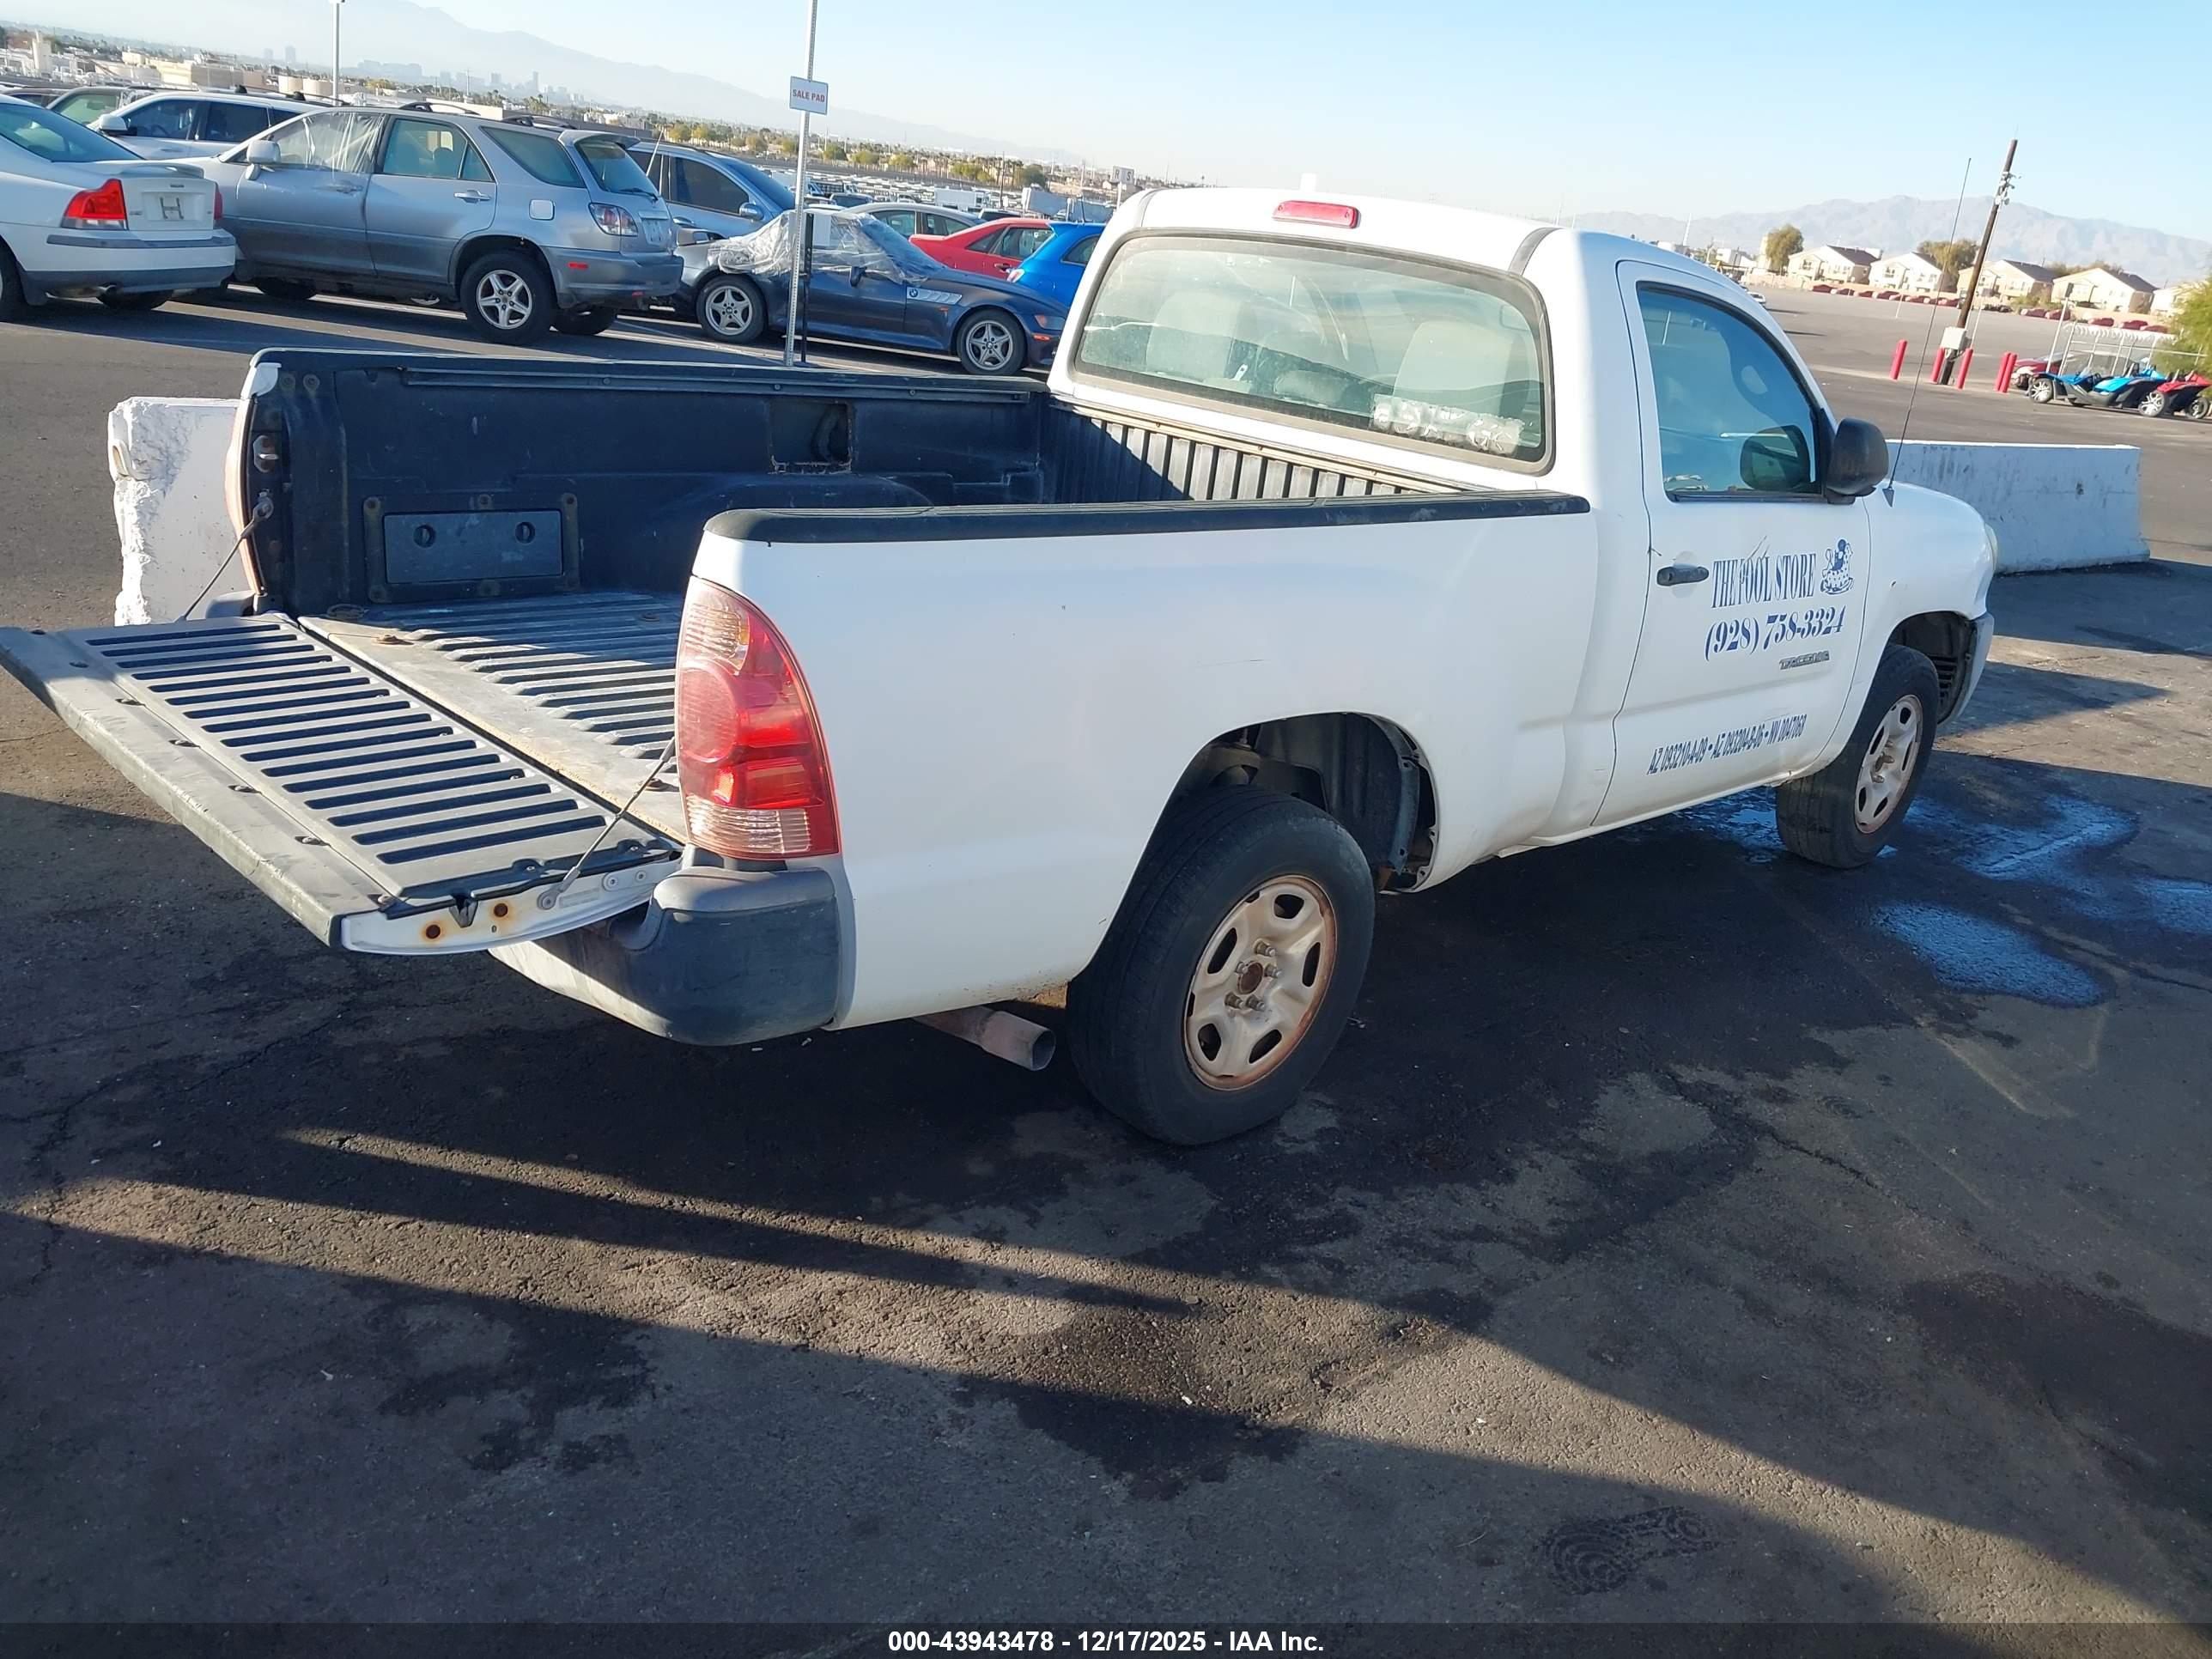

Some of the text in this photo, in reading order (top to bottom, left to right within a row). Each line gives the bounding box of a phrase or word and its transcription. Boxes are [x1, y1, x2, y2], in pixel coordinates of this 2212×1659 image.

[793, 89, 825, 102] SALE PAD
[1711, 553, 1816, 608] THE POOL STORE
[1705, 605, 1846, 662] (928) 758-3324
[1646, 747, 1663, 775] AZ
